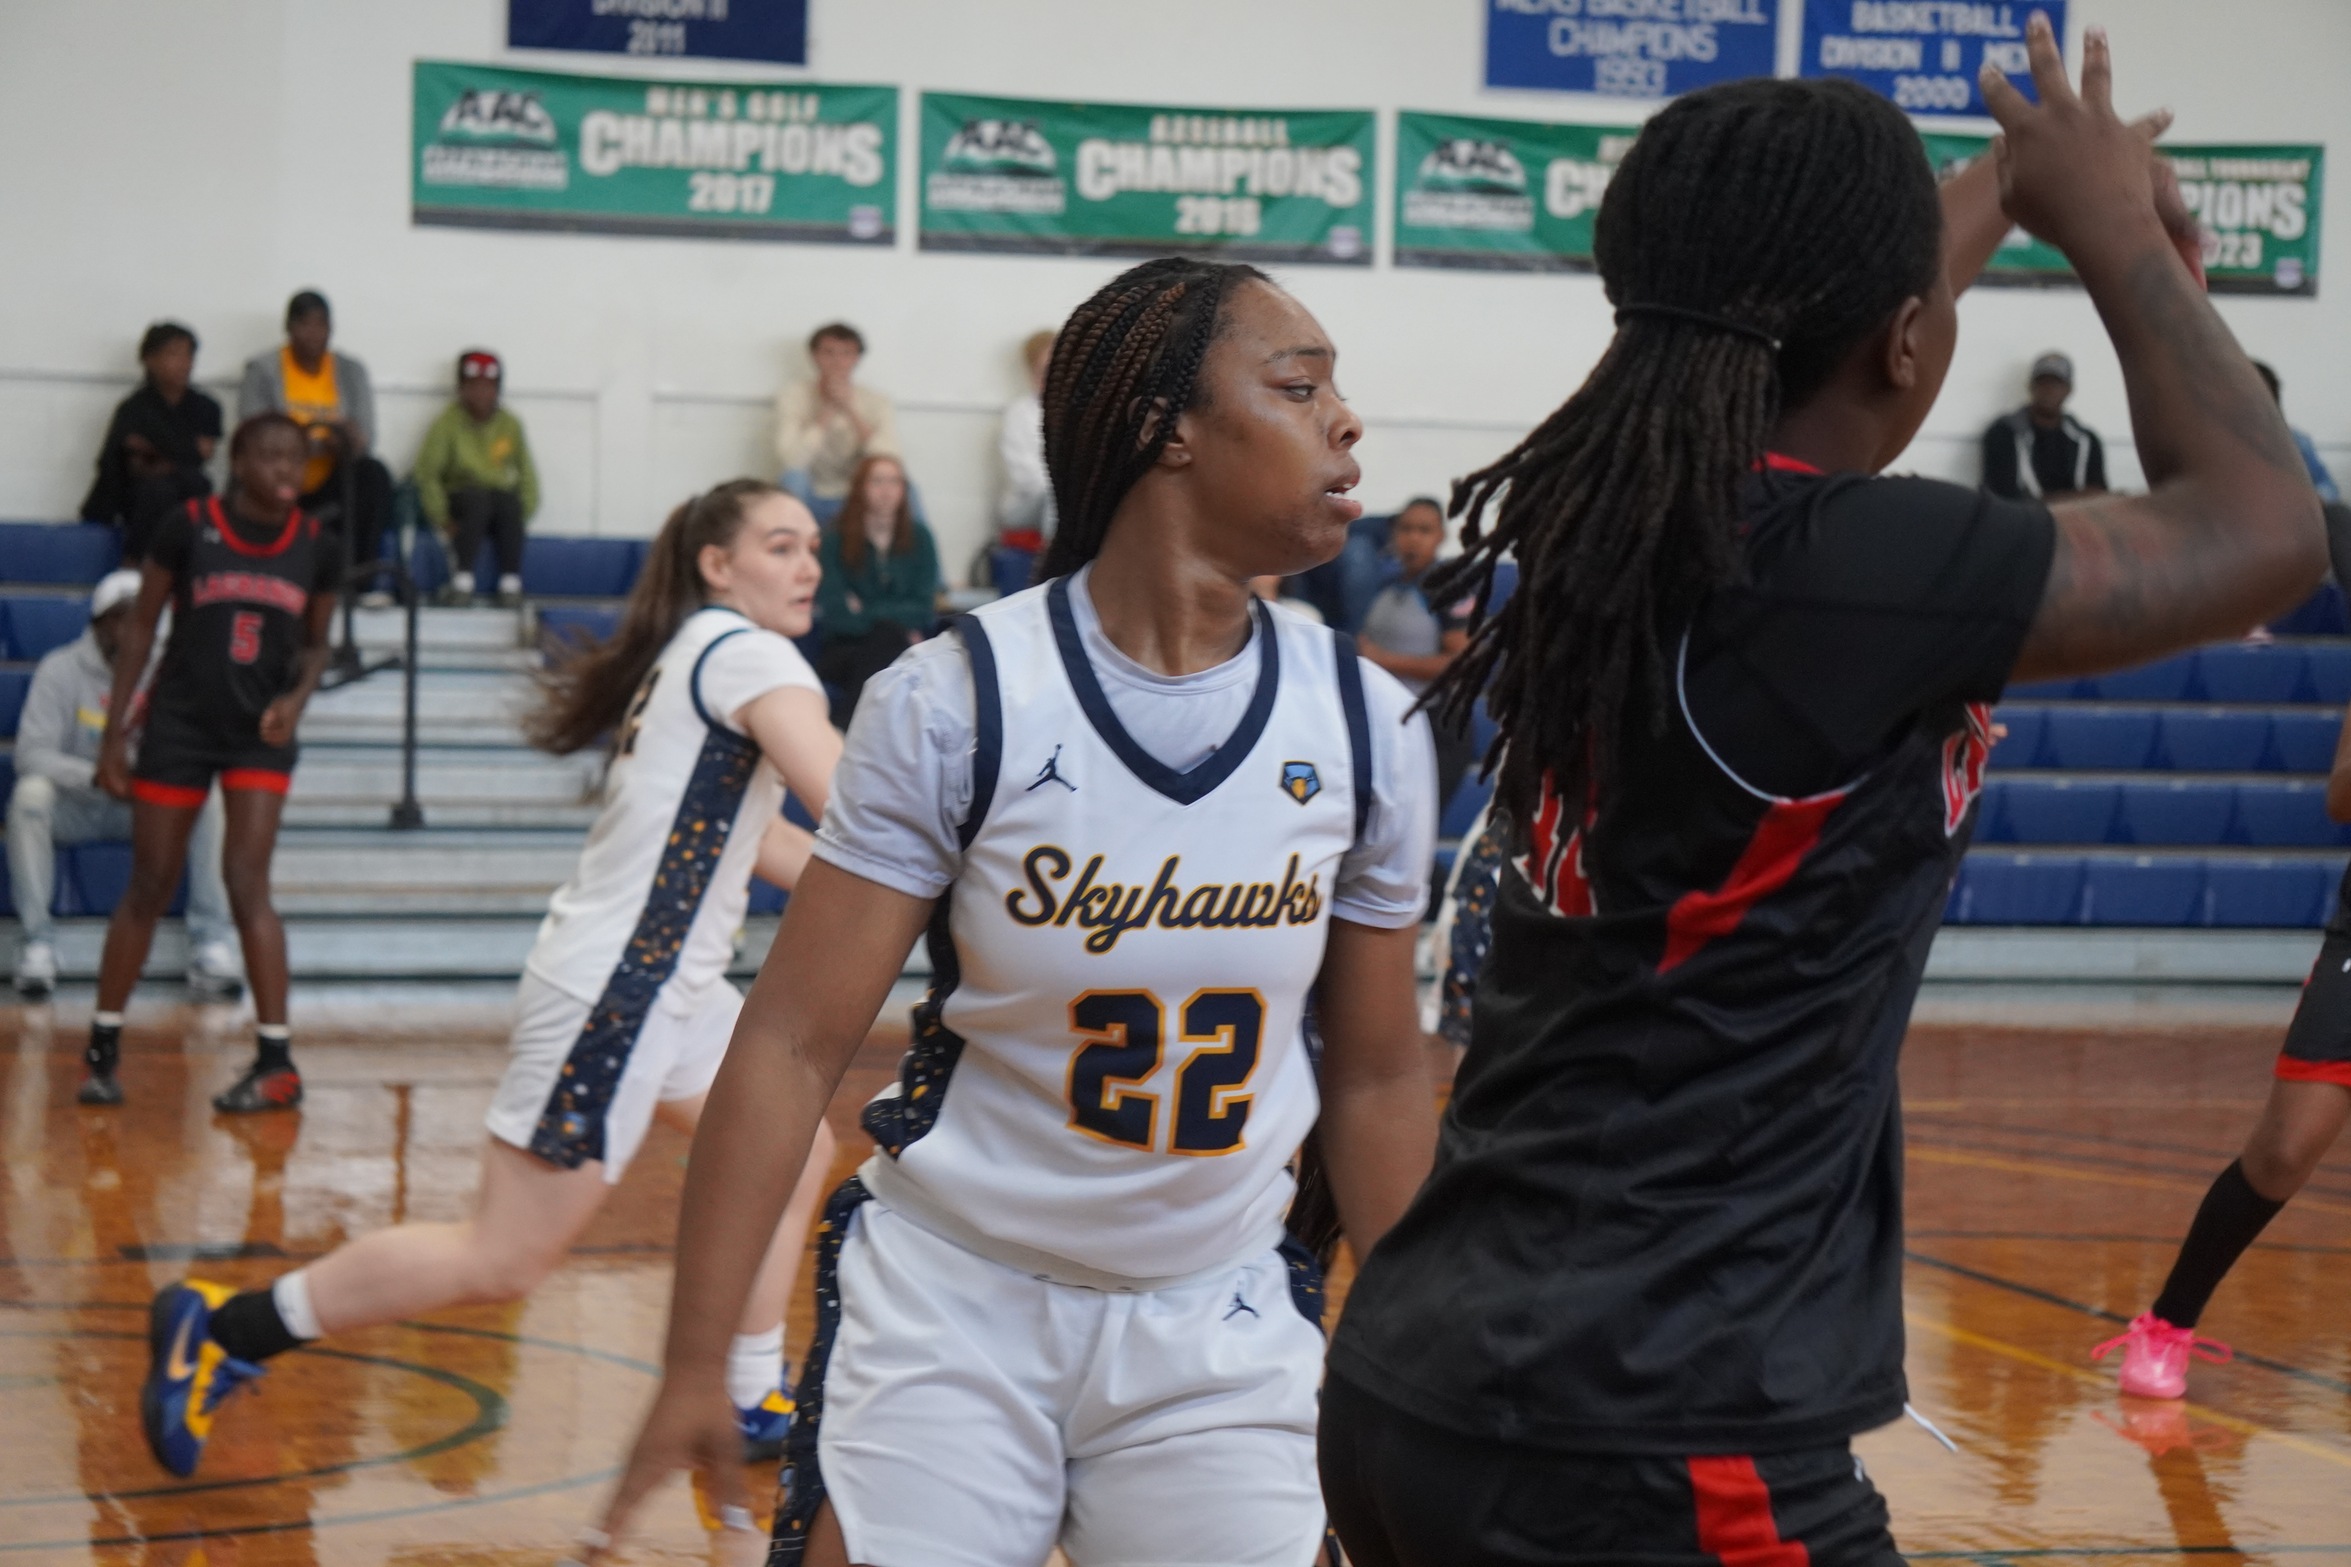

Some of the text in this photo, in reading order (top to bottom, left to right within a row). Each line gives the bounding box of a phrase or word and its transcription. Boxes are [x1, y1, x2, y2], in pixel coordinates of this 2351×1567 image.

[1548, 17, 1718, 63] CHAMPIONS
[1851, 1, 2021, 38] BASKETBALL
[1820, 34, 1922, 70] DIVISION
[746, 90, 819, 122] GOLF
[1893, 74, 1970, 110] 2000
[579, 109, 884, 187] CHAMPIONS
[687, 170, 775, 214] 2017
[1076, 138, 1362, 208] CHAMPIONS
[2177, 180, 2306, 240] PIONS
[2199, 230, 2262, 270] 023
[229, 610, 263, 664] 5
[1006, 845, 1321, 955] Skyhawks
[1065, 987, 1268, 1157] 22
